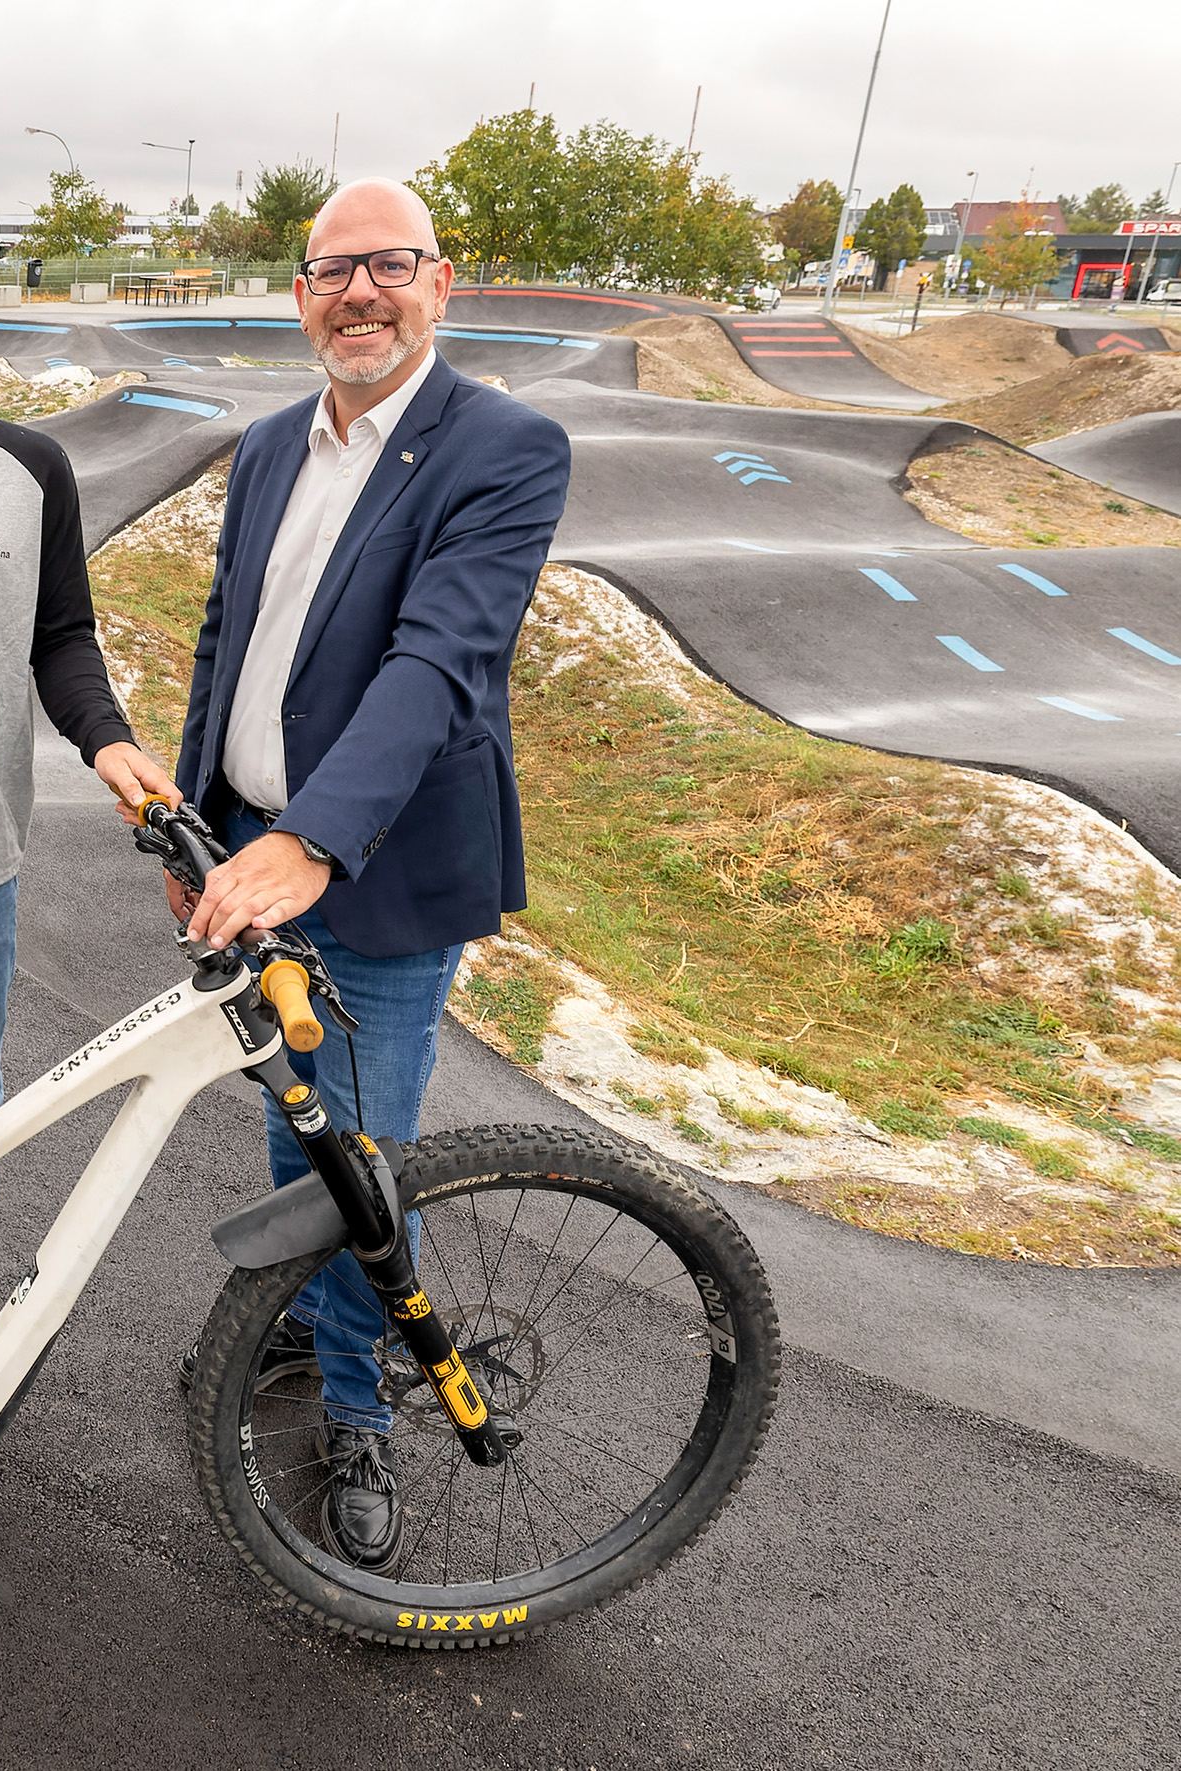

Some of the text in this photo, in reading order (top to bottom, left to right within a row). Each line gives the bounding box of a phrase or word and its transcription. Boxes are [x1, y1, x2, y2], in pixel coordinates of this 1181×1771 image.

[1131, 223, 1181, 233] SPAR
[49, 991, 182, 1083] UNPLUGGED
[409, 1298, 429, 1318] 38
[696, 1273, 726, 1319] 1700
[240, 1422, 271, 1510] DT SWISS
[396, 1604, 529, 1632] MAXXIS
